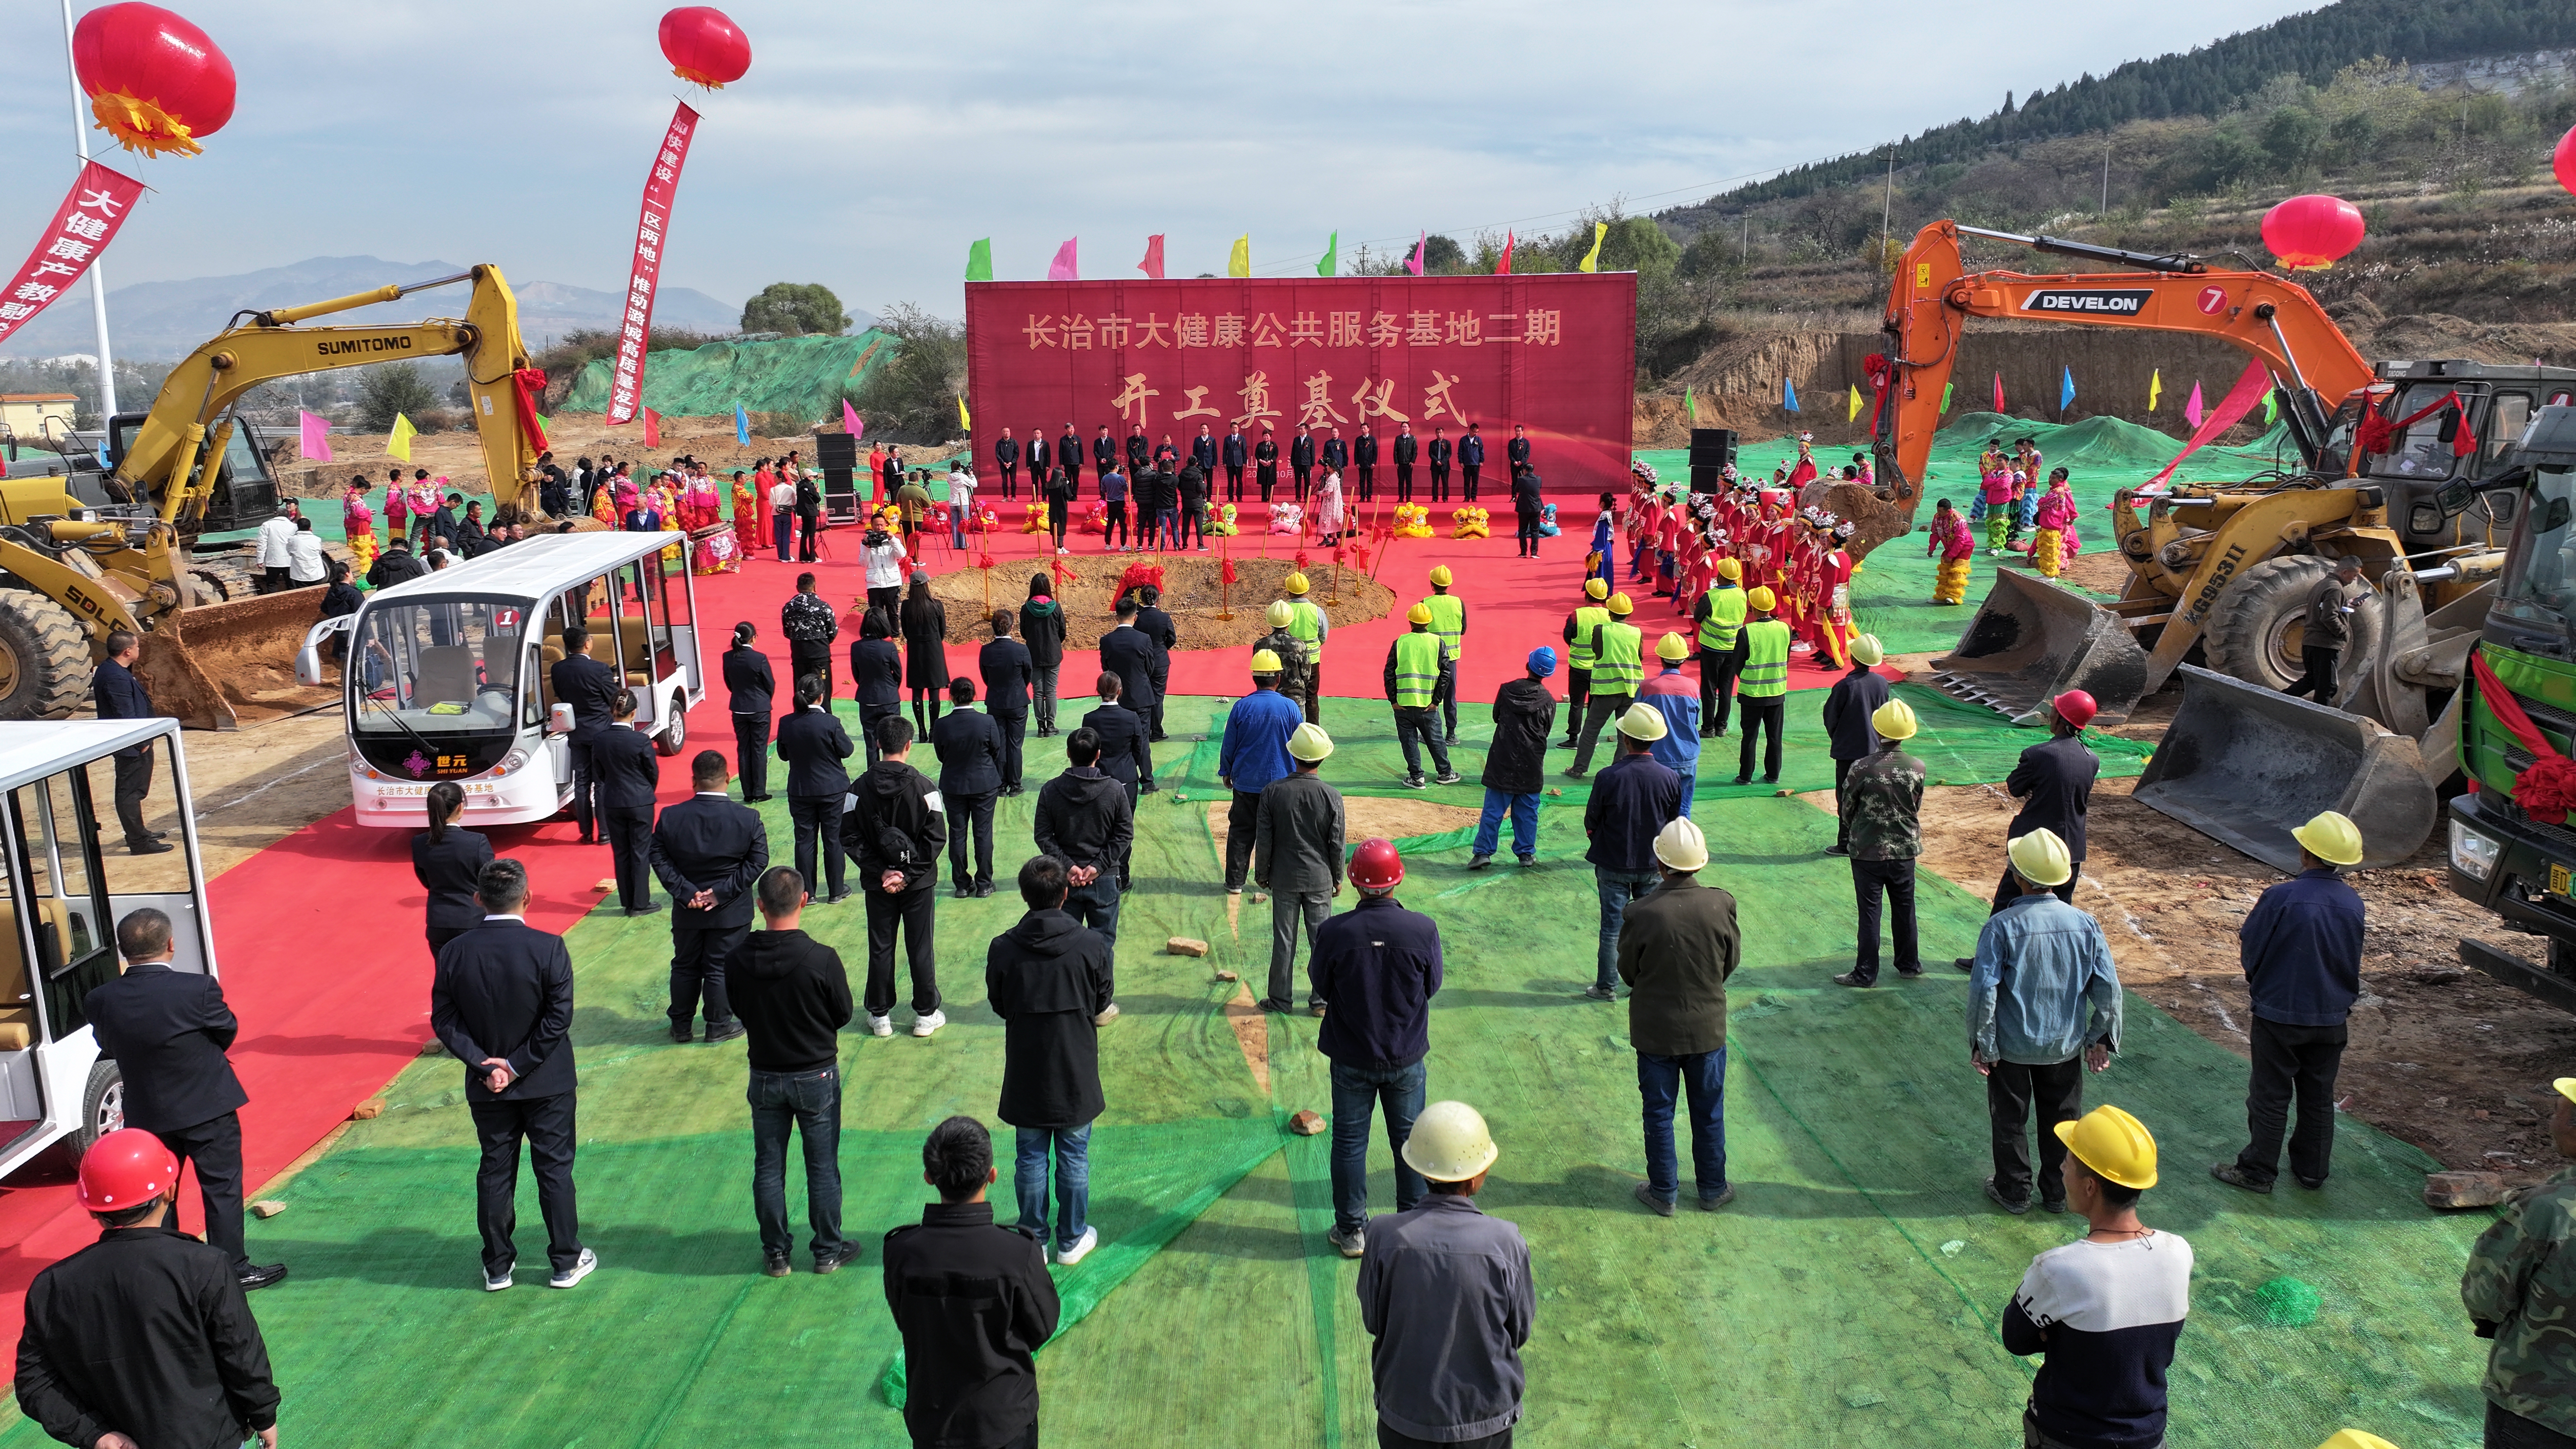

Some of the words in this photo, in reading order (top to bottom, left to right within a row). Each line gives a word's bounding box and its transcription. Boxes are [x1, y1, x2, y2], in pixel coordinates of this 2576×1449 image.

[2042, 295, 2138, 311] DEVELON
[2204, 289, 2222, 312] 7
[1022, 308, 1561, 350] 长治市大健康公共服务基地二期
[318, 336, 411, 355] SUMITOMO
[1110, 369, 1468, 431] 开工奠基仪式
[64, 584, 128, 633] SDLG
[500, 611, 512, 625] 1
[436, 755, 467, 767] 世元
[377, 783, 494, 796] 长治市大健康务基地
